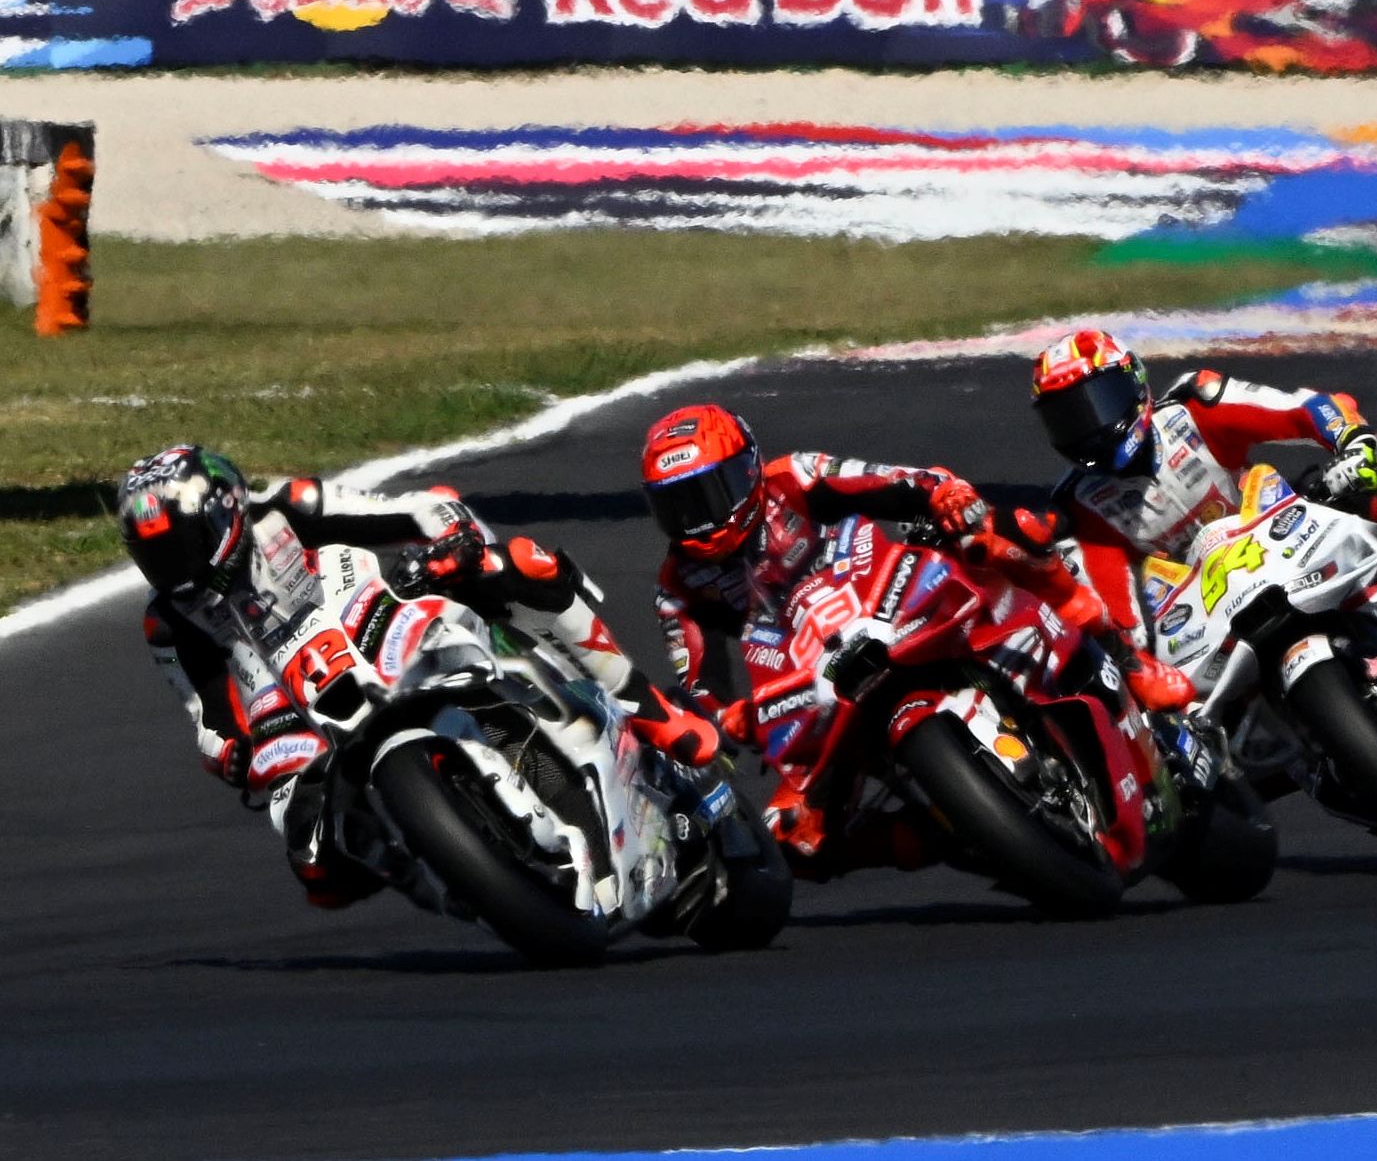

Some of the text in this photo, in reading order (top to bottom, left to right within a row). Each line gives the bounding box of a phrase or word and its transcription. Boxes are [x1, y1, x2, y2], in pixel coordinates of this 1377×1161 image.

[661, 450, 691, 470] SHOEI
[876, 553, 917, 620] Lenovo
[1200, 534, 1268, 616] 54
[789, 582, 863, 670] 93
[757, 689, 816, 725] Lenovo
